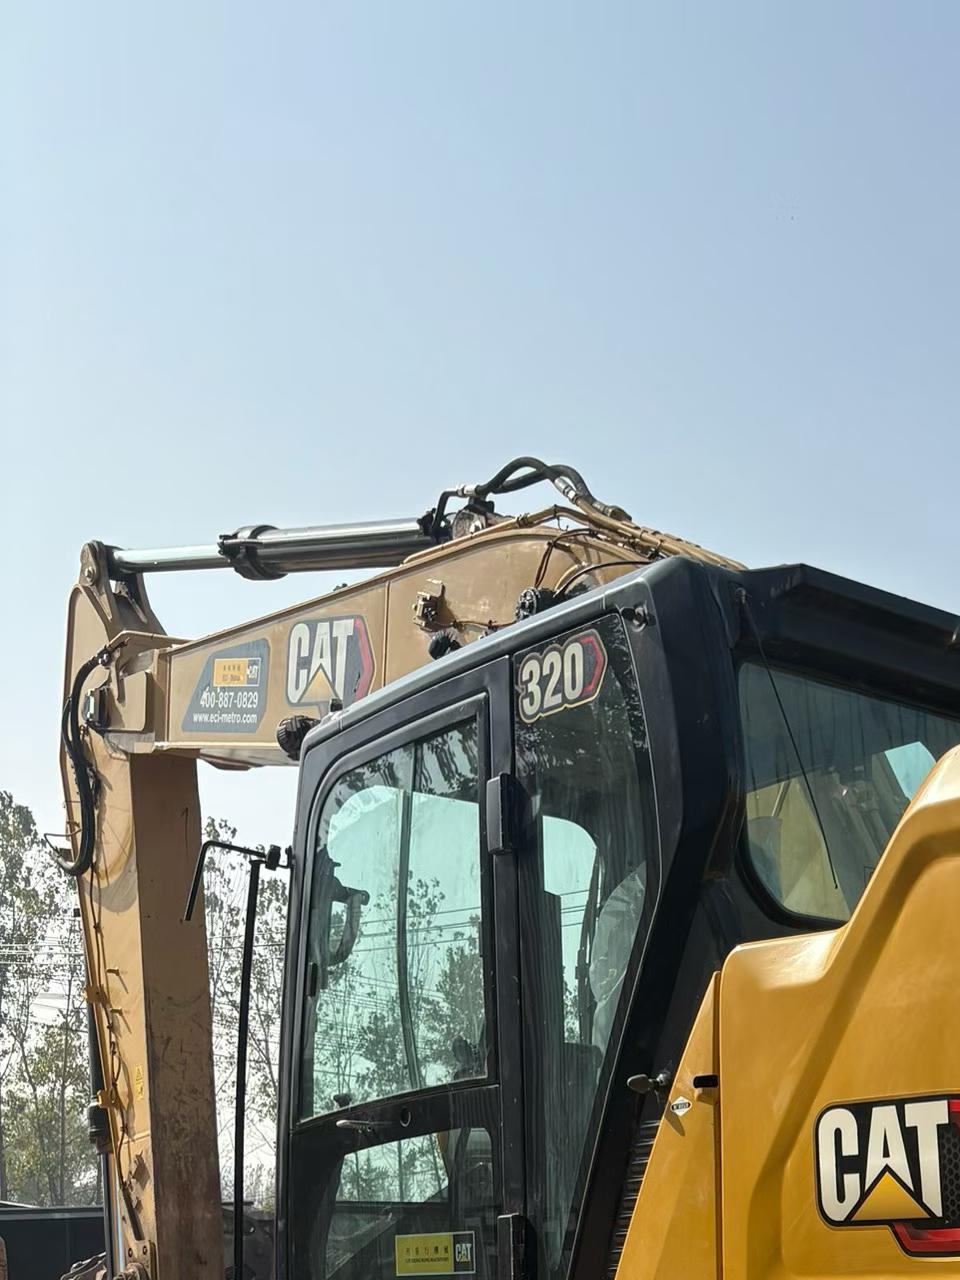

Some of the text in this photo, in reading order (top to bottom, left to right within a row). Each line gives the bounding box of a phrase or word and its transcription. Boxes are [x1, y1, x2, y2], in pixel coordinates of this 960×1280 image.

[287, 619, 354, 703] CAT
[522, 642, 583, 716] 320
[193, 711, 257, 723] www.eci-metro.com
[200, 691, 258, 708] 400-887-0829
[818, 1100, 949, 1221] CAT
[455, 1243, 471, 1262] CAT
